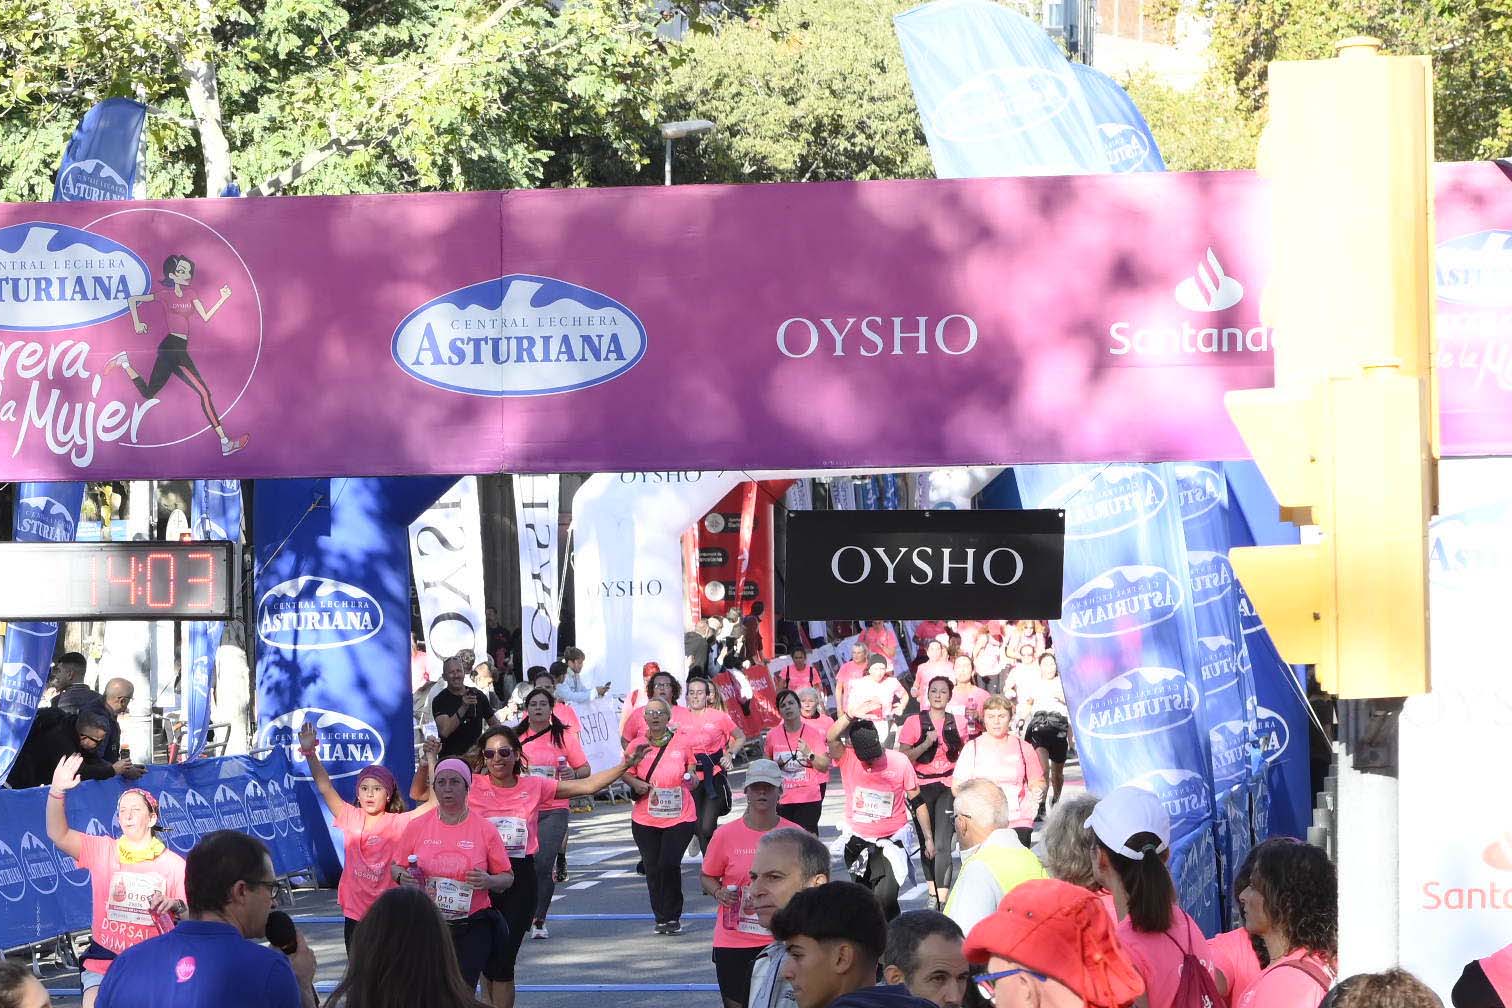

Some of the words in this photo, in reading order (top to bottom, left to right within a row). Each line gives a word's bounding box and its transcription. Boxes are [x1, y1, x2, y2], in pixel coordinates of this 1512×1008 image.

[54, 258, 125, 271] LECHERA
[450, 317, 529, 330] CENTRAL
[537, 314, 619, 329] LECHERA
[776, 313, 979, 358] OYSHO
[411, 322, 627, 366] ASTURIANA
[12, 372, 160, 467] Mujer
[831, 545, 1023, 586] OYSHO
[273, 600, 316, 609] CENTRAL
[320, 601, 369, 609] LECHERA
[261, 606, 373, 634] ASTURIANA
[321, 733, 370, 741] LECHERA
